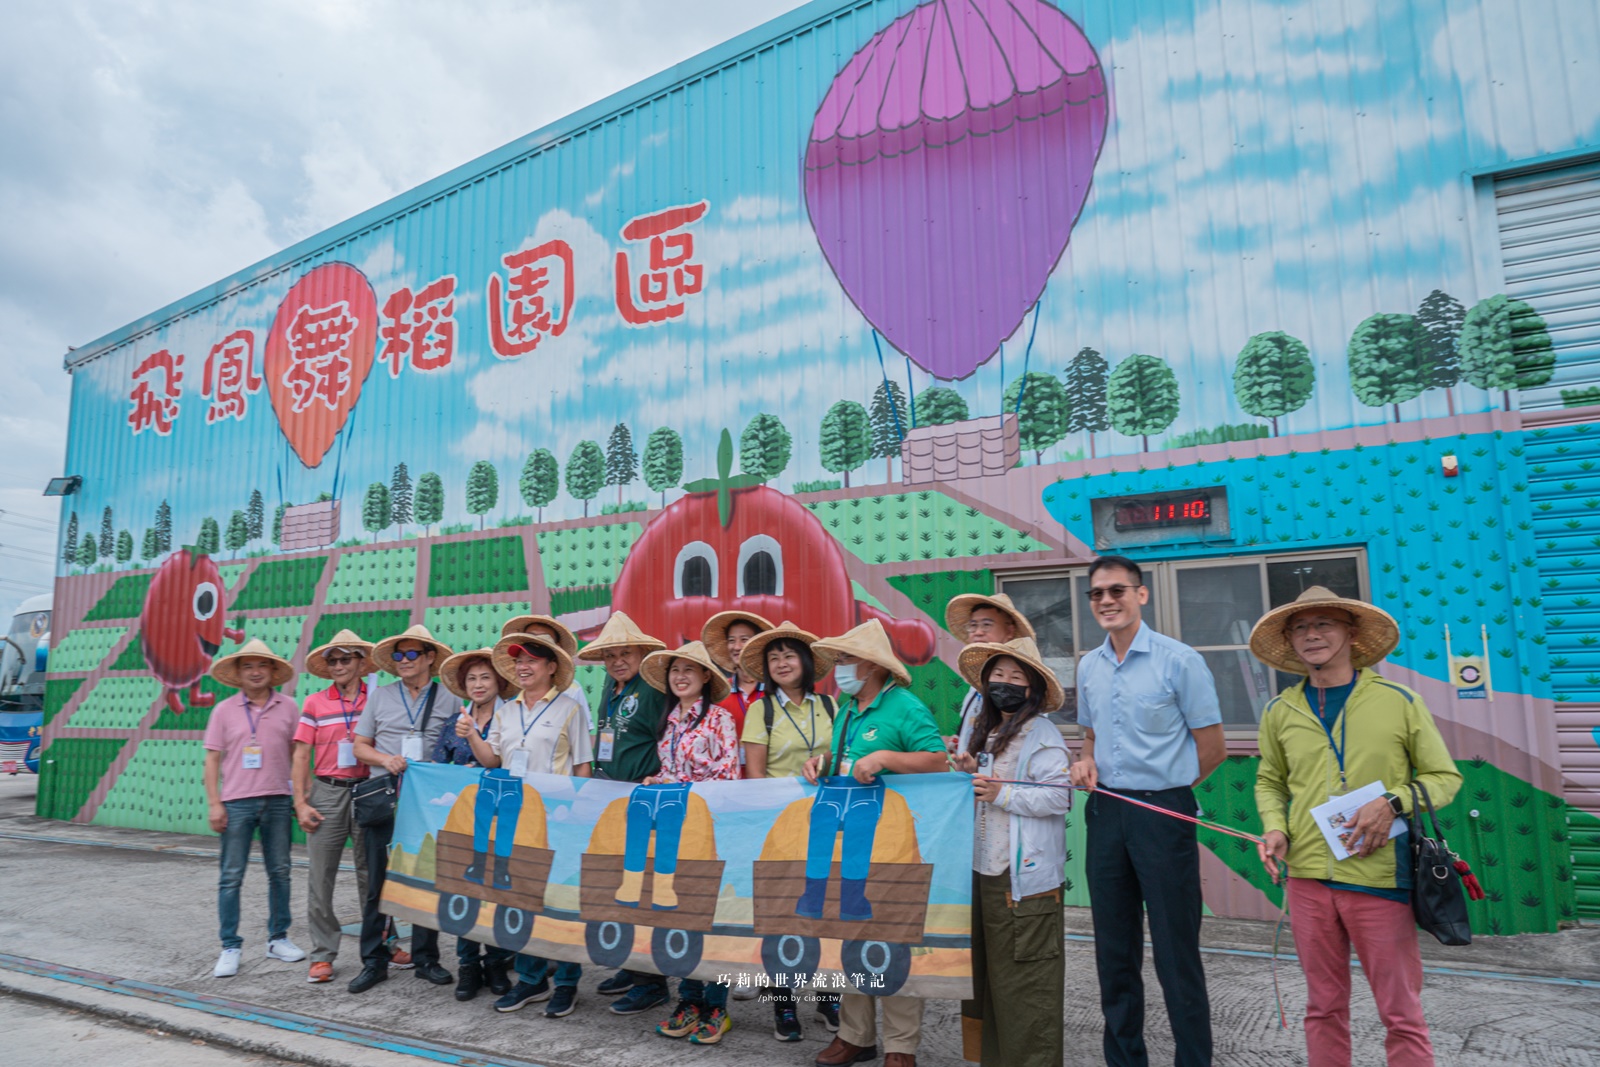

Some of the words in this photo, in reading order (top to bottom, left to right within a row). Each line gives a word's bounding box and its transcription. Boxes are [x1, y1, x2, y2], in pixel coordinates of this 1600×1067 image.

[127, 201, 708, 435] 飛鳳舞稻園區
